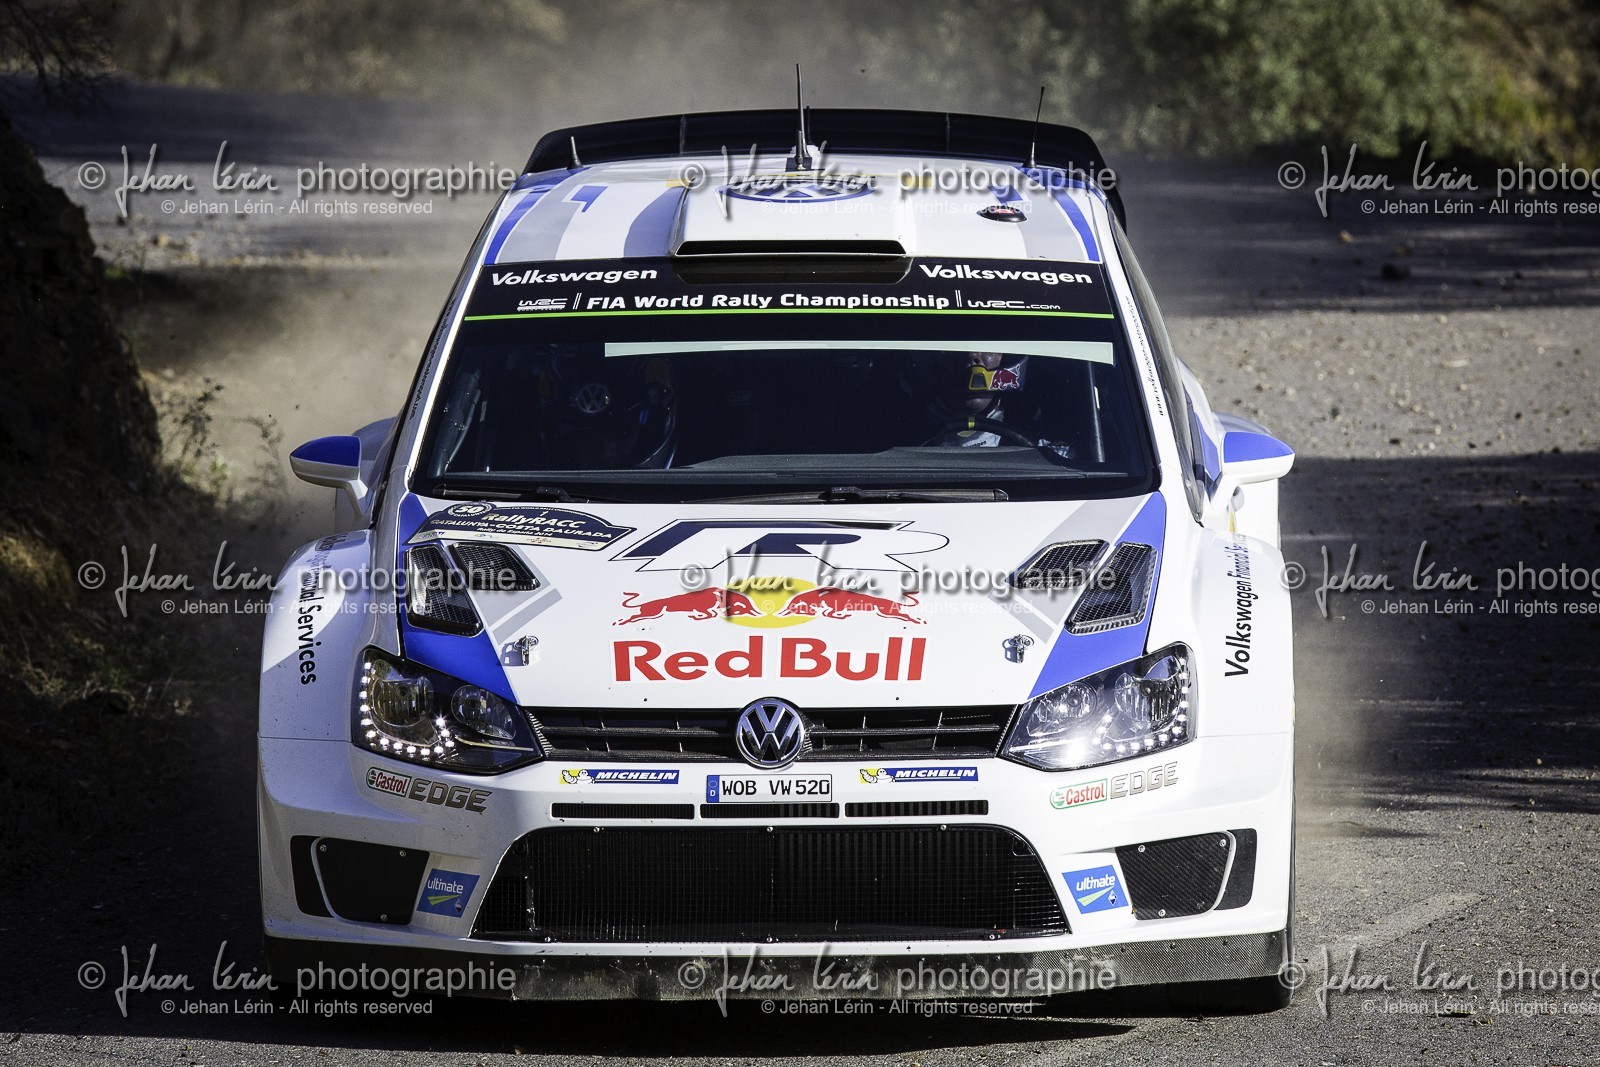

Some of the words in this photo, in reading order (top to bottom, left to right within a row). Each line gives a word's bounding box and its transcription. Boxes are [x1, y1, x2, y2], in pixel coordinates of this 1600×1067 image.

[492, 268, 658, 286] Volkswagen
[919, 264, 1092, 285] Volkswagen
[586, 297, 626, 310] FIA
[634, 295, 704, 309] World
[712, 294, 773, 309] Rally
[780, 294, 949, 310] Championship
[481, 513, 586, 528] RallyRACC
[543, 527, 612, 539] DAURADA
[1224, 580, 1258, 677] Volkswagen
[298, 604, 322, 685] Services
[613, 635, 763, 681] Red
[780, 637, 927, 681] Bull
[738, 698, 804, 768] VW
[595, 771, 678, 780] MICHELIN
[895, 769, 976, 778] MICHELIN
[374, 771, 409, 797] Castrol
[409, 778, 492, 813] EDGE
[722, 780, 757, 795] WOB
[769, 780, 791, 795] VW
[1065, 782, 1106, 805] Castrol
[1110, 761, 1179, 799] EDGE
[427, 877, 465, 895] ultimate
[1076, 873, 1116, 892] ultimate
